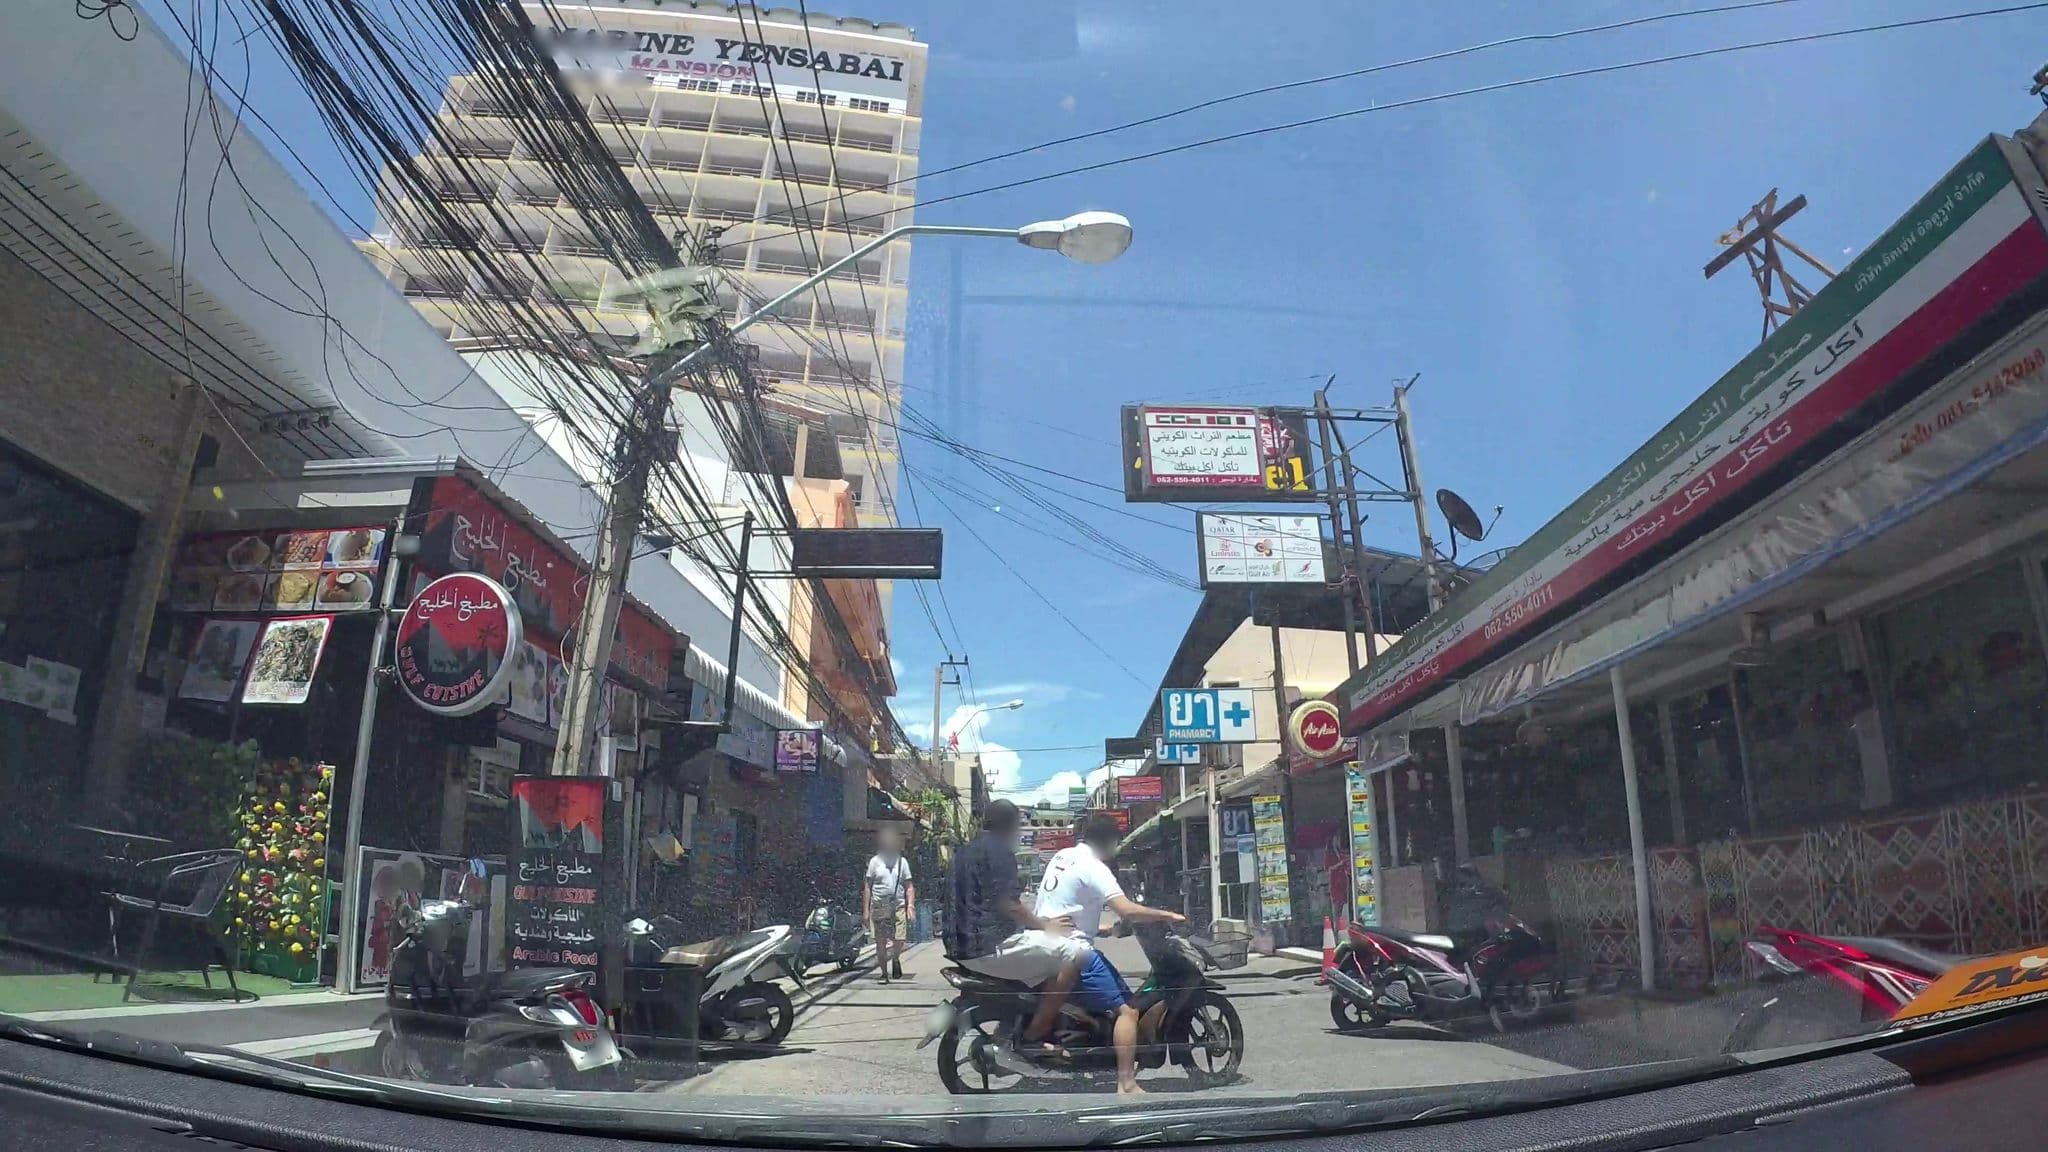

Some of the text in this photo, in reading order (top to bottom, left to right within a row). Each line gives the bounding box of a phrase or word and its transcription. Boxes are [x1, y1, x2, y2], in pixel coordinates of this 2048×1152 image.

[630, 54, 756, 82] MANSION
[715, 36, 905, 82] YENSABAI
[1153, 430, 1252, 443] مطعم التراث الكويتي
[1650, 444, 1722, 503] خليجي
[1617, 514, 1666, 551] بيتك
[457, 591, 498, 622] مطبخ
[1484, 584, 1553, 640] 062-550-4011
[1169, 693, 1214, 727] ยา
[1169, 728, 1216, 739] PHAMARCY
[1224, 810, 1250, 835] ยา
[556, 857, 593, 884] مطبخ
[513, 946, 598, 966] Arabic Food
